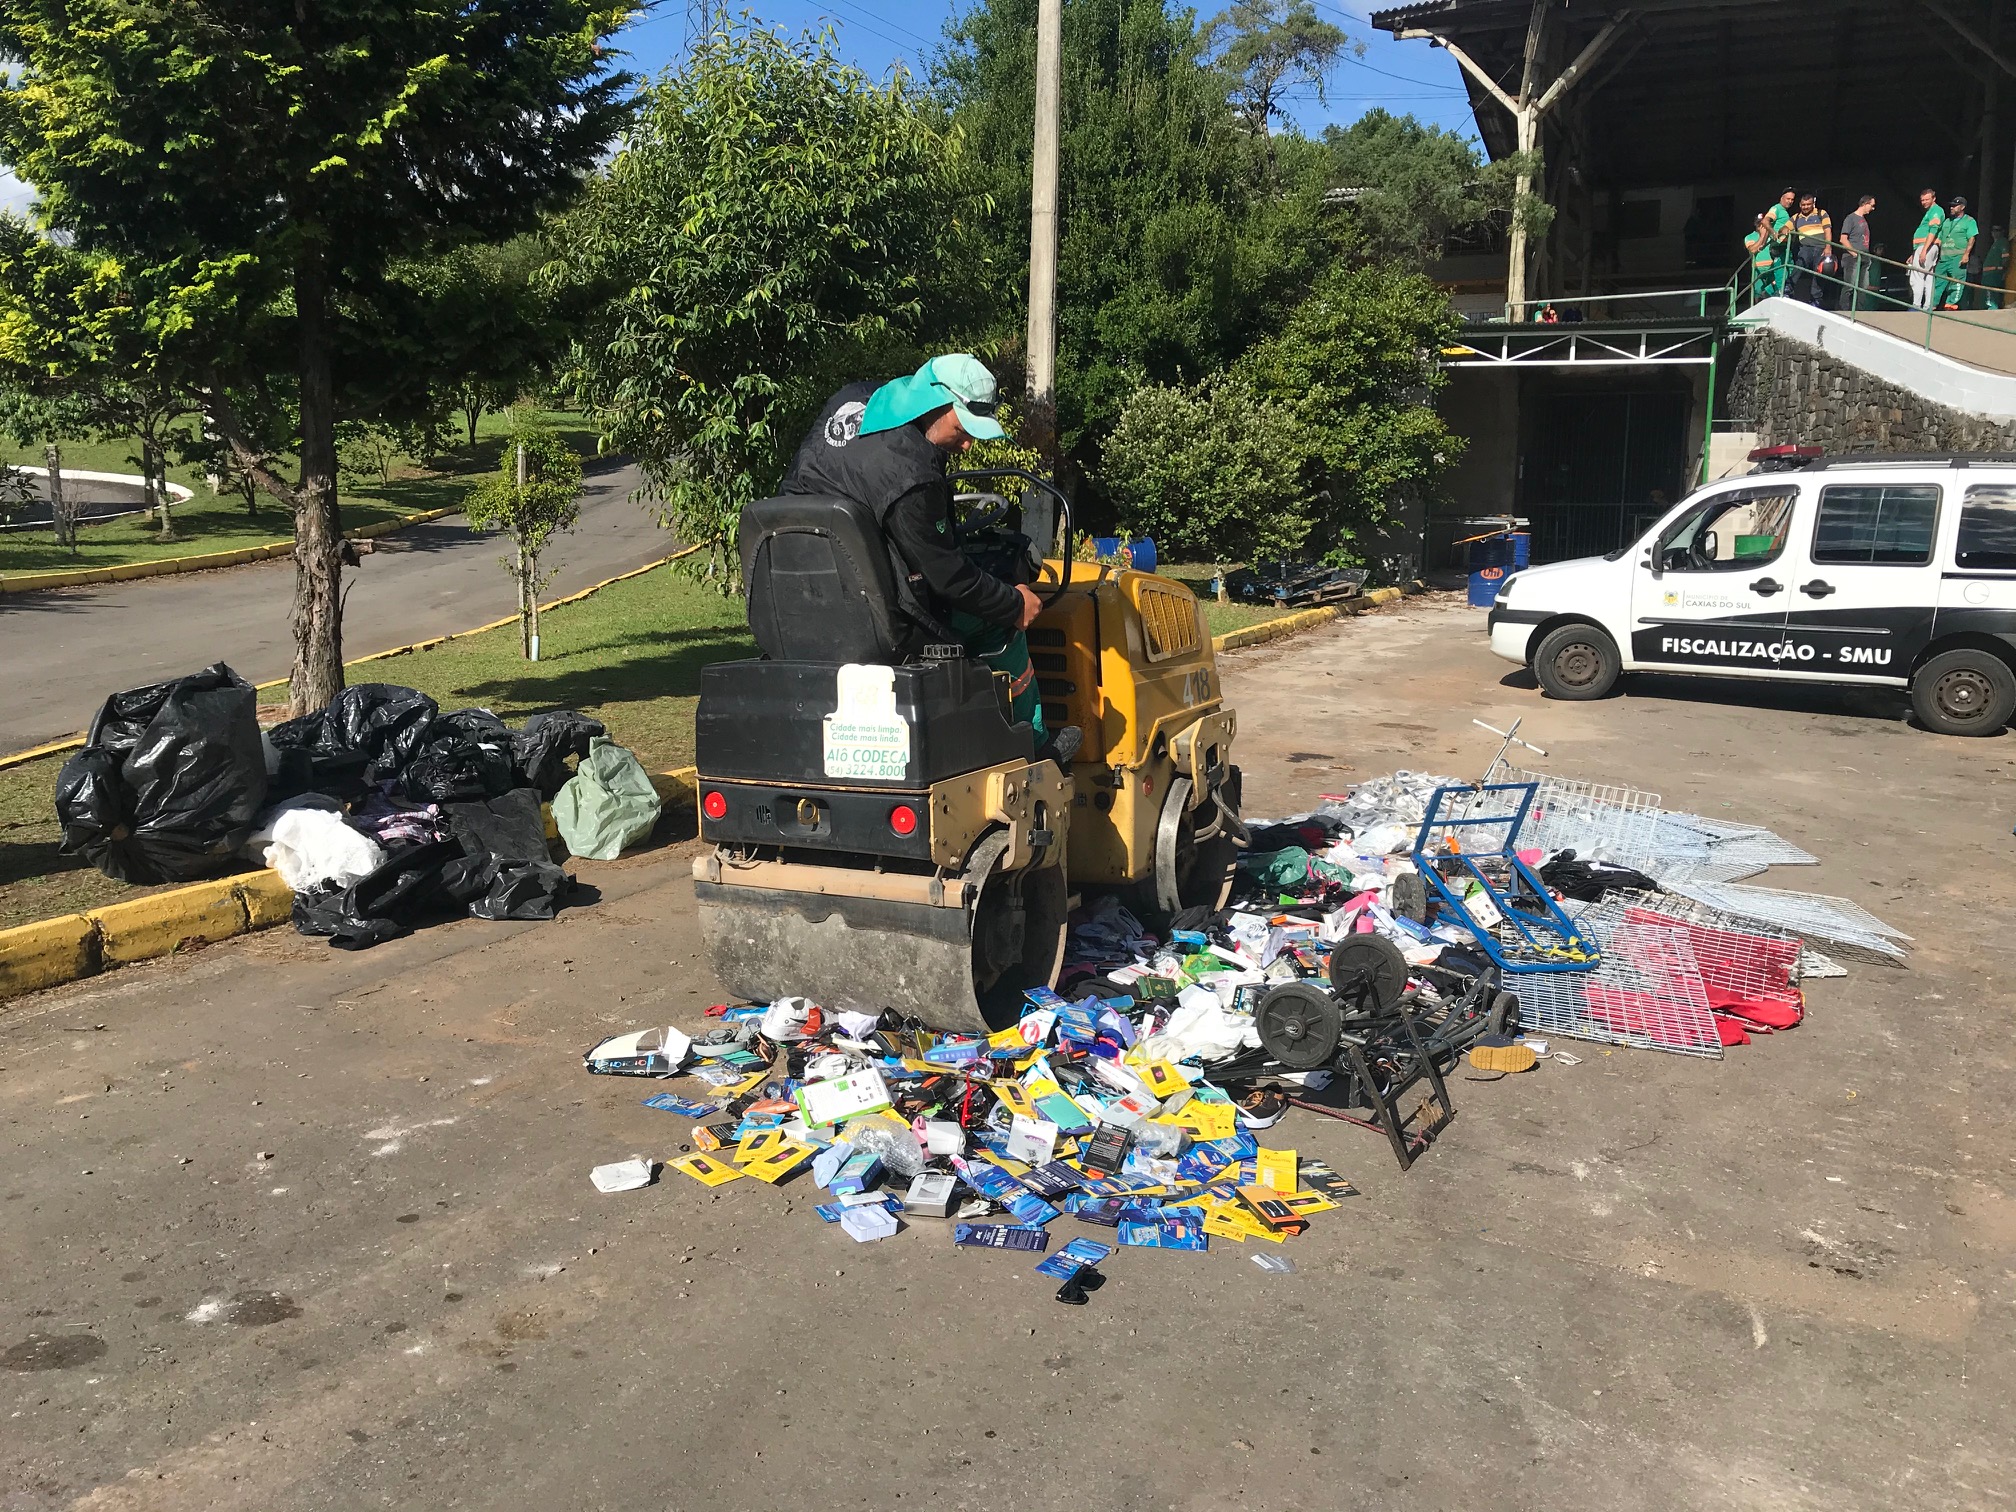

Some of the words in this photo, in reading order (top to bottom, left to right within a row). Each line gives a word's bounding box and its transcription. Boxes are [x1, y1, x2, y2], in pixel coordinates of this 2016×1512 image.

[1685, 600, 1717, 608] CAXIAS
[1719, 601, 1734, 609] DO
[1736, 602, 1751, 610] SUL
[1662, 637, 1815, 662] FISCALIZAÇÃO
[1838, 646, 1892, 665] SMU
[1183, 667, 1210, 708] 418
[830, 723, 857, 732] Cidade
[859, 725, 876, 733] mais
[831, 732, 858, 741] Cidade
[826, 748, 848, 762] Alô
[852, 749, 907, 764] CODECA
[827, 766, 843, 776] (54)
